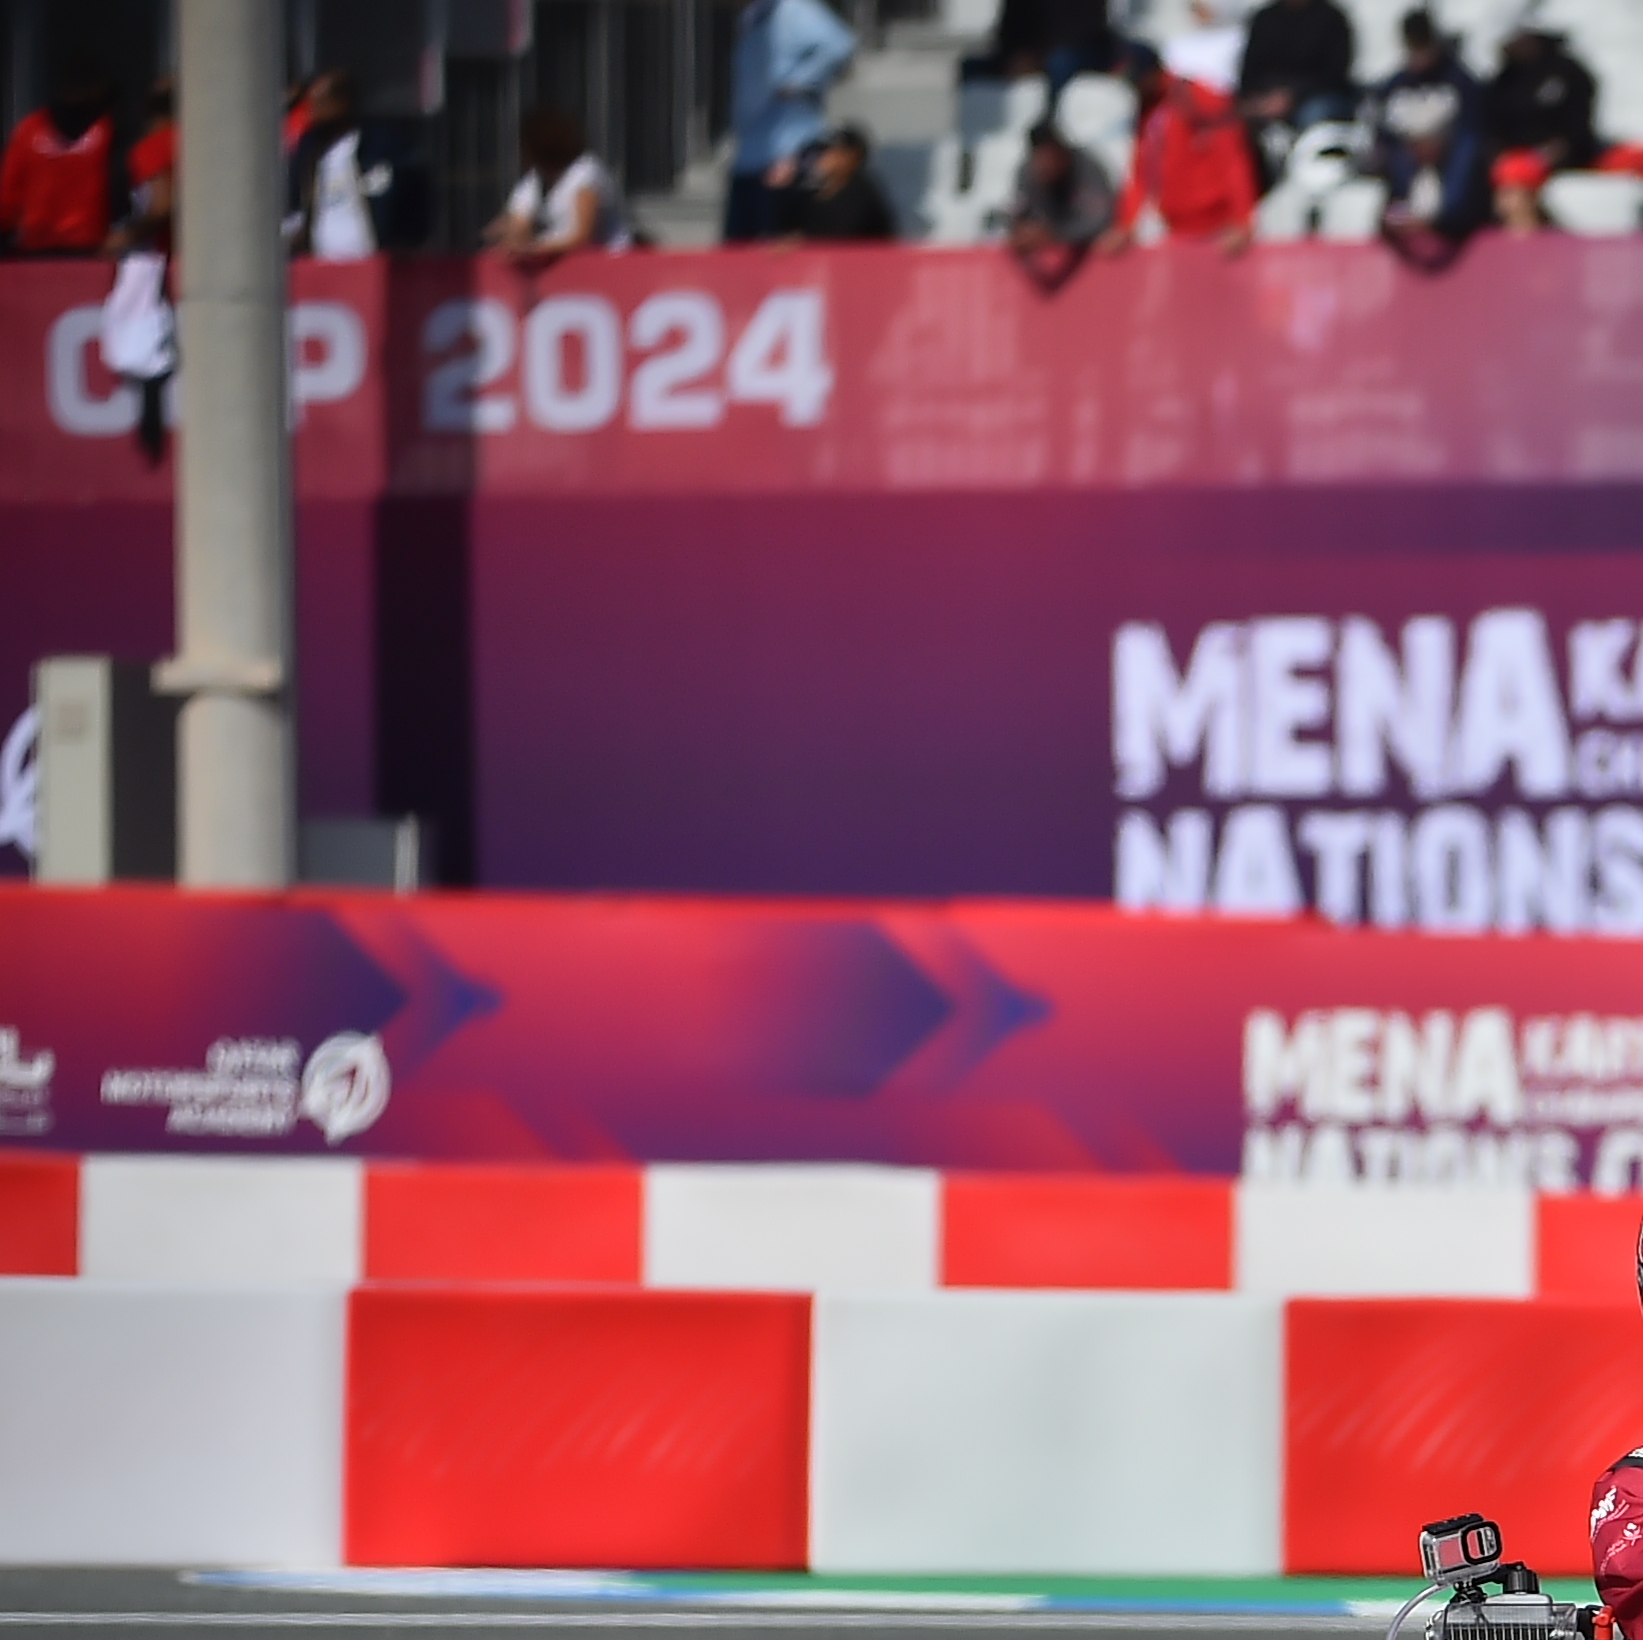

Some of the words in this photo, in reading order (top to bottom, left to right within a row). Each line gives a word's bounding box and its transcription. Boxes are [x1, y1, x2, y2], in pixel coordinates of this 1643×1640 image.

[47, 302, 367, 438] CP
[422, 287, 832, 434] 2024
[1112, 606, 1567, 799] MENA
[1243, 1005, 1522, 1125] MENA
